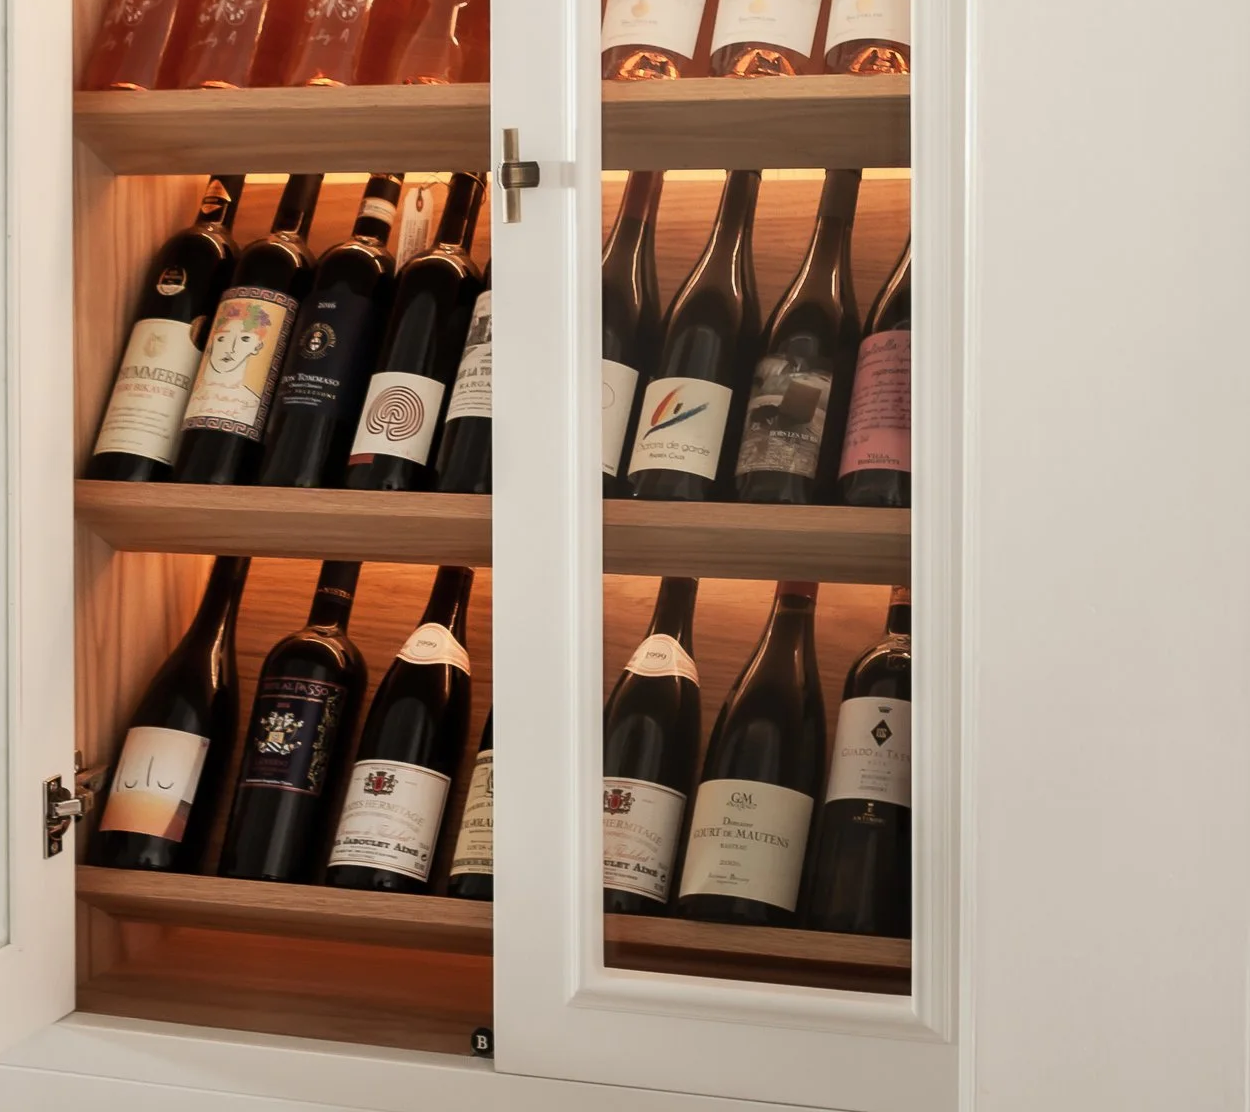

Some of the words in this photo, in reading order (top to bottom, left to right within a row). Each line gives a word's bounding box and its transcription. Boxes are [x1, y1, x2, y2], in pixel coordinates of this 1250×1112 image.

[119, 365, 191, 391] UMMERER
[666, 440, 680, 450] de
[841, 748, 873, 757] GUADO
[343, 837, 391, 849] JABOULET
[735, 829, 790, 848] MAUTENS
[476, 1035, 488, 1050] B
